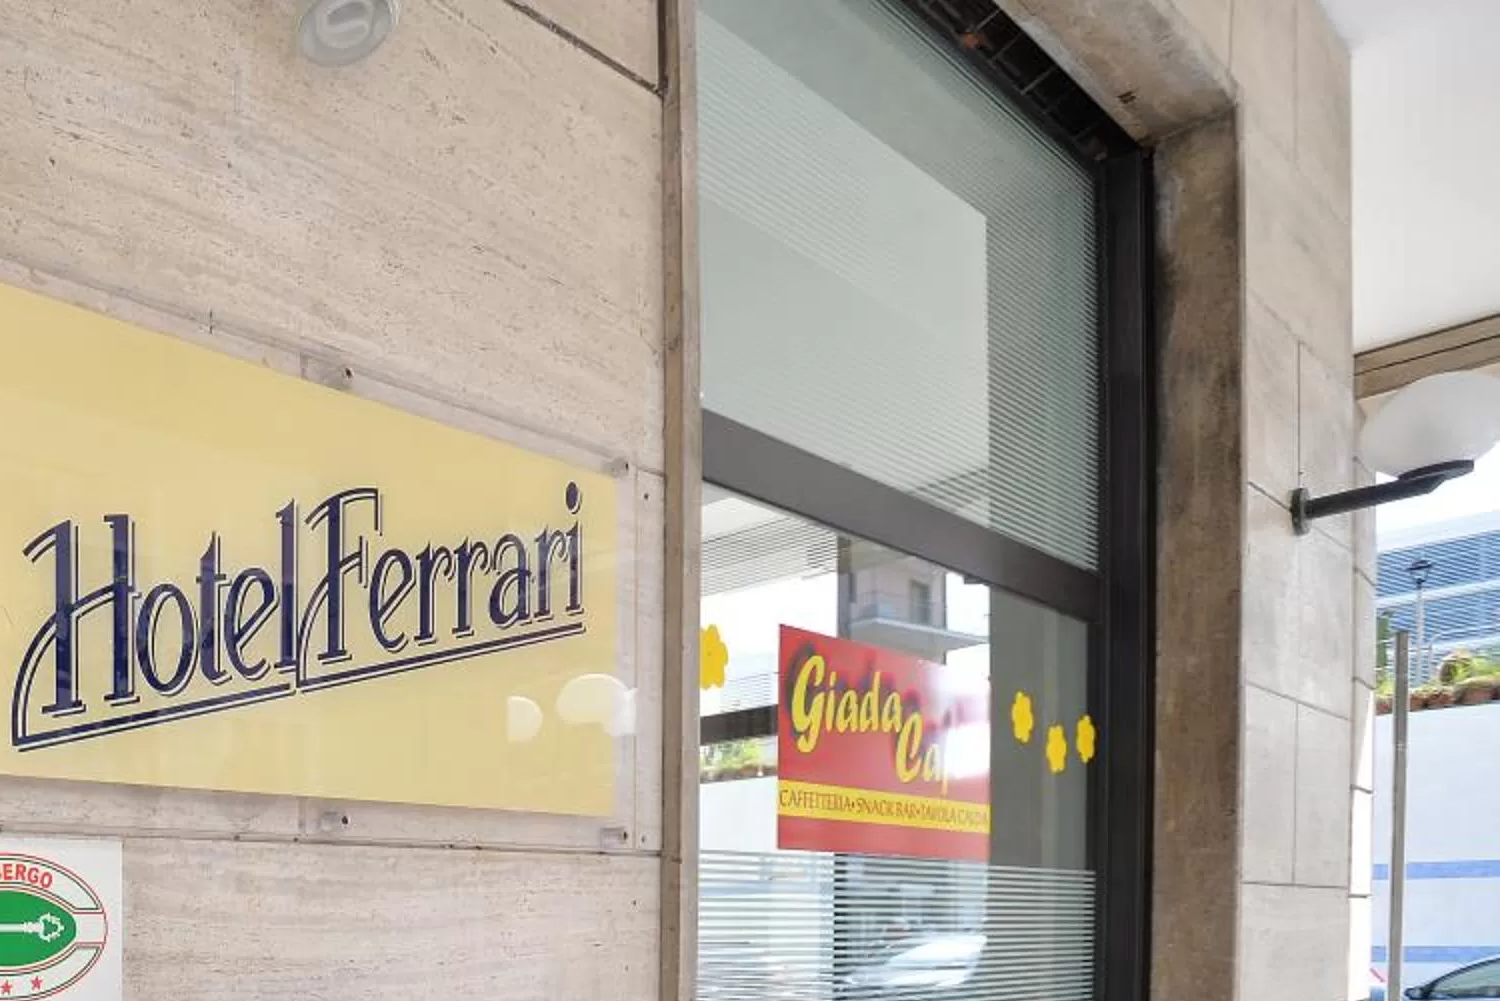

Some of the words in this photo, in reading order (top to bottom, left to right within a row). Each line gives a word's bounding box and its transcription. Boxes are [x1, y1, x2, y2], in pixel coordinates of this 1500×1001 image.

[12, 497, 299, 742] Hotel
[297, 481, 587, 690] Ferrari
[791, 655, 903, 753] Giada
